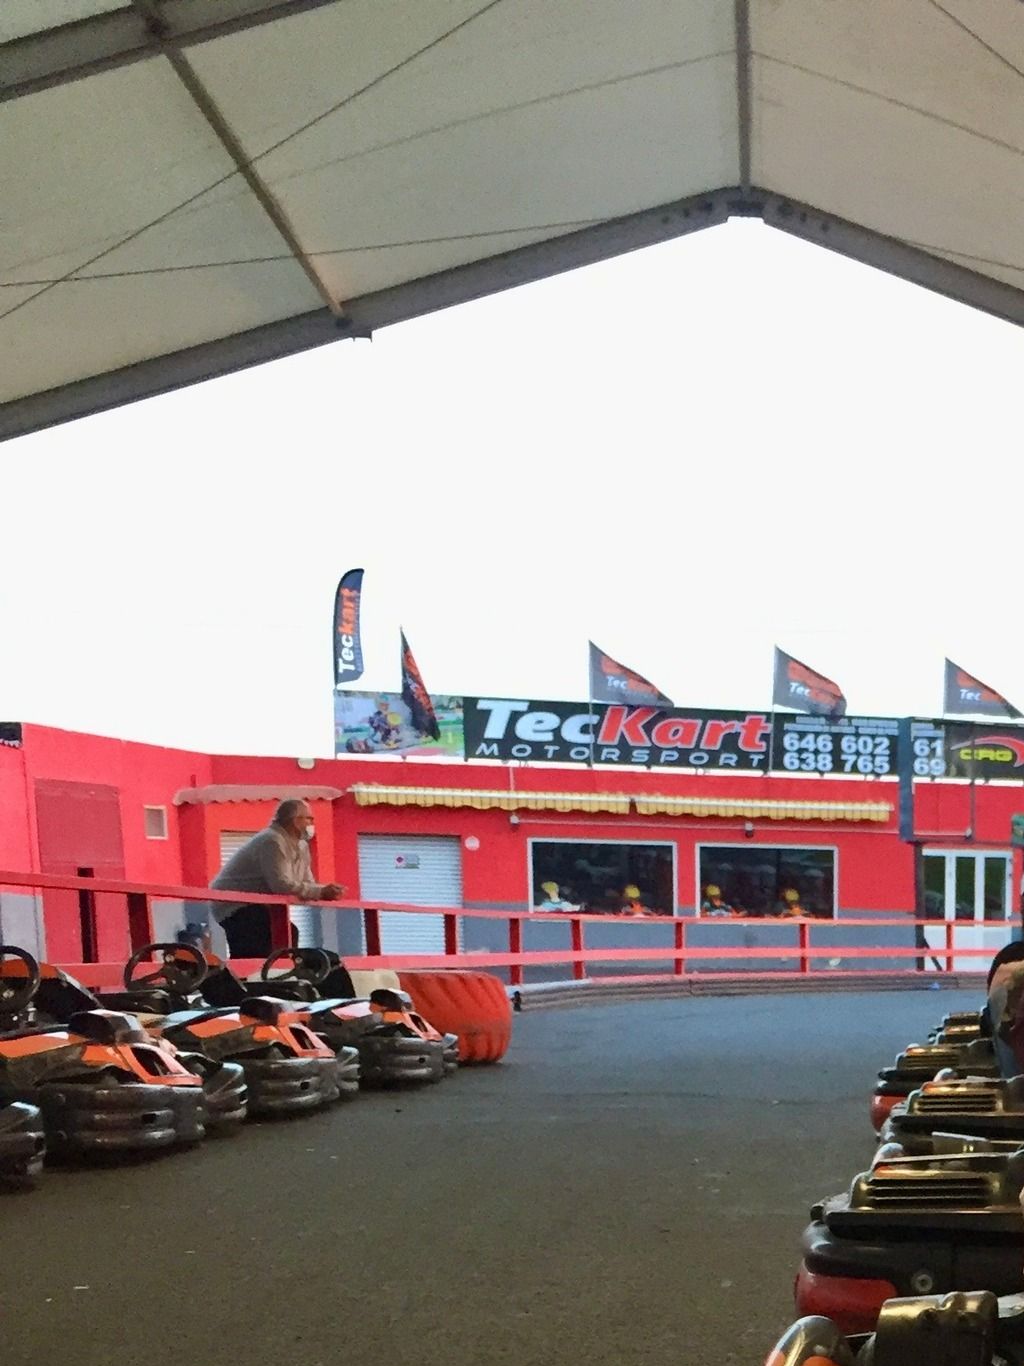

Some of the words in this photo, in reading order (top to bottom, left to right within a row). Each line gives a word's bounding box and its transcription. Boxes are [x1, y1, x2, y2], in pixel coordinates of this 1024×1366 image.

[475, 698, 771, 753] TecKart
[475, 742, 767, 768] MOTORSPORT
[783, 733, 833, 753] 646
[840, 735, 890, 755] 602
[913, 738, 944, 757] 61
[783, 752, 833, 772] 638
[840, 754, 890, 774] 765
[913, 757, 946, 776] 69
